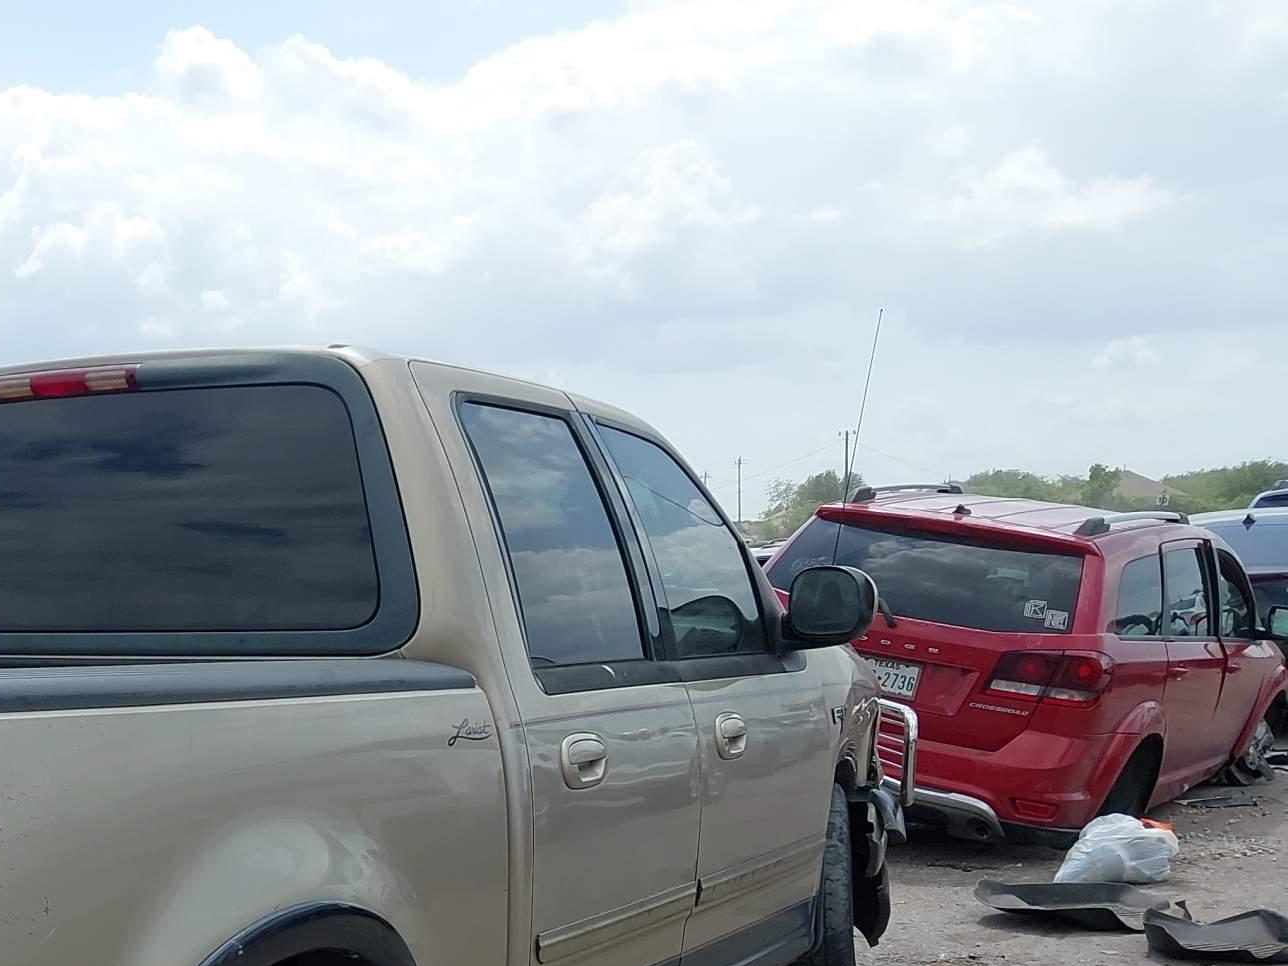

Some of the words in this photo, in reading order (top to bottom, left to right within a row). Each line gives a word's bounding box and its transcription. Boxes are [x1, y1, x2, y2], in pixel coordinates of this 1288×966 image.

[858, 635, 940, 654] ODGE
[874, 660, 901, 671] TEXAS
[872, 669, 916, 692] 2736
[968, 702, 1030, 717] CROSSROAD
